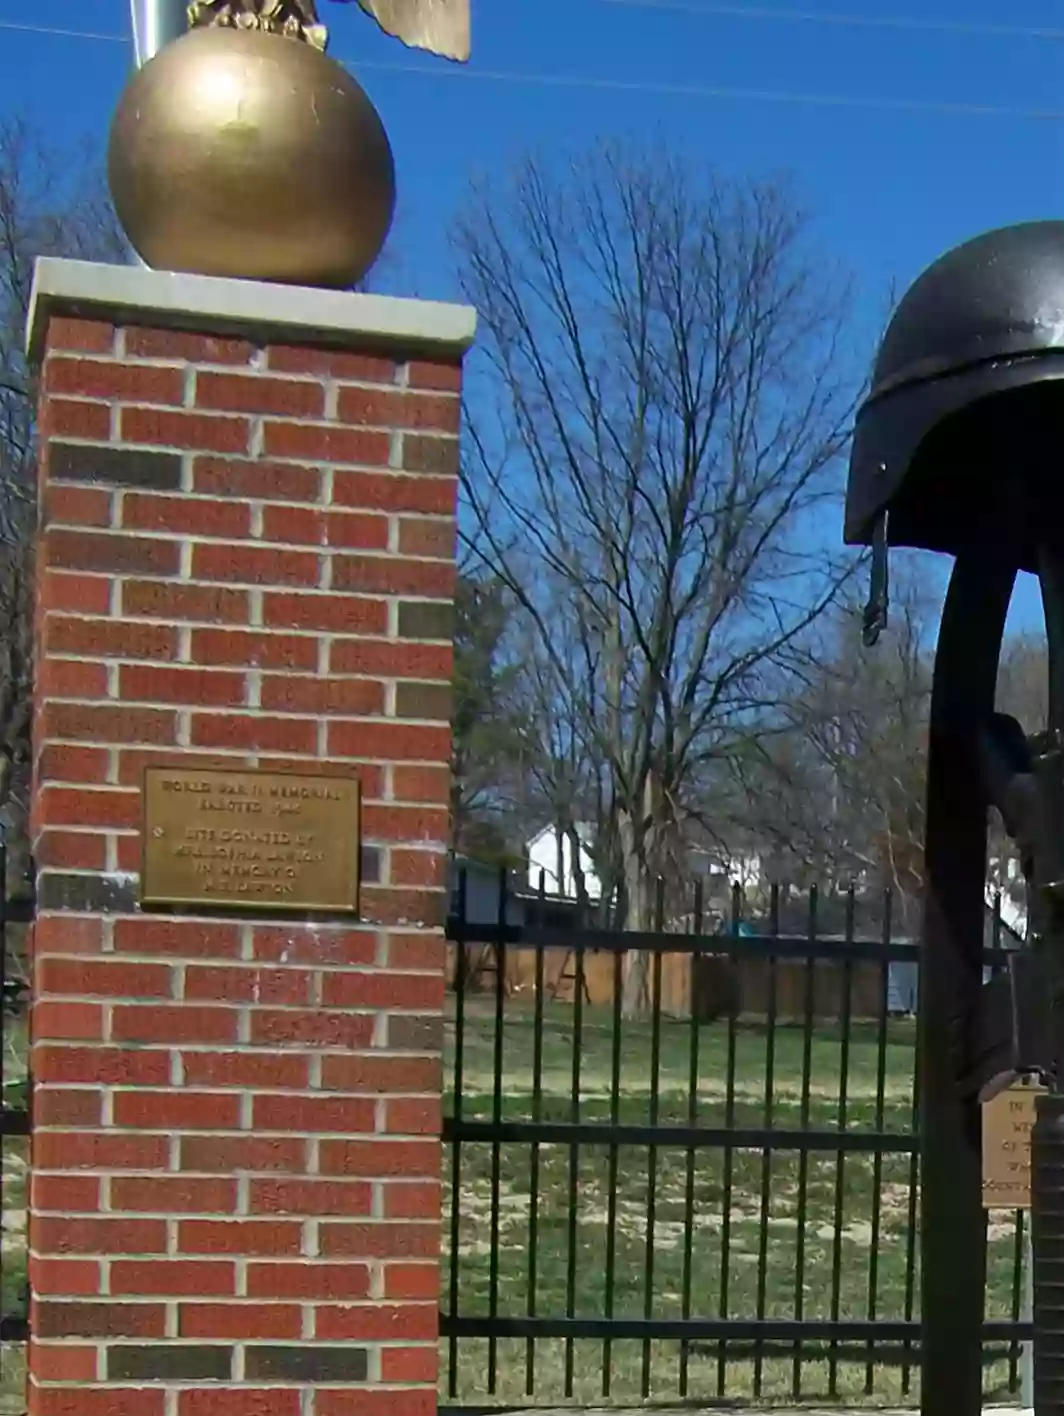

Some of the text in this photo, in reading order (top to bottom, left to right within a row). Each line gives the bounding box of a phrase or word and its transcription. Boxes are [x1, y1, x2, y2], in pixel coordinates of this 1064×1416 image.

[161, 780, 211, 794] WORLD
[219, 783, 248, 796] WAR
[269, 785, 342, 802] MEMORIAL
